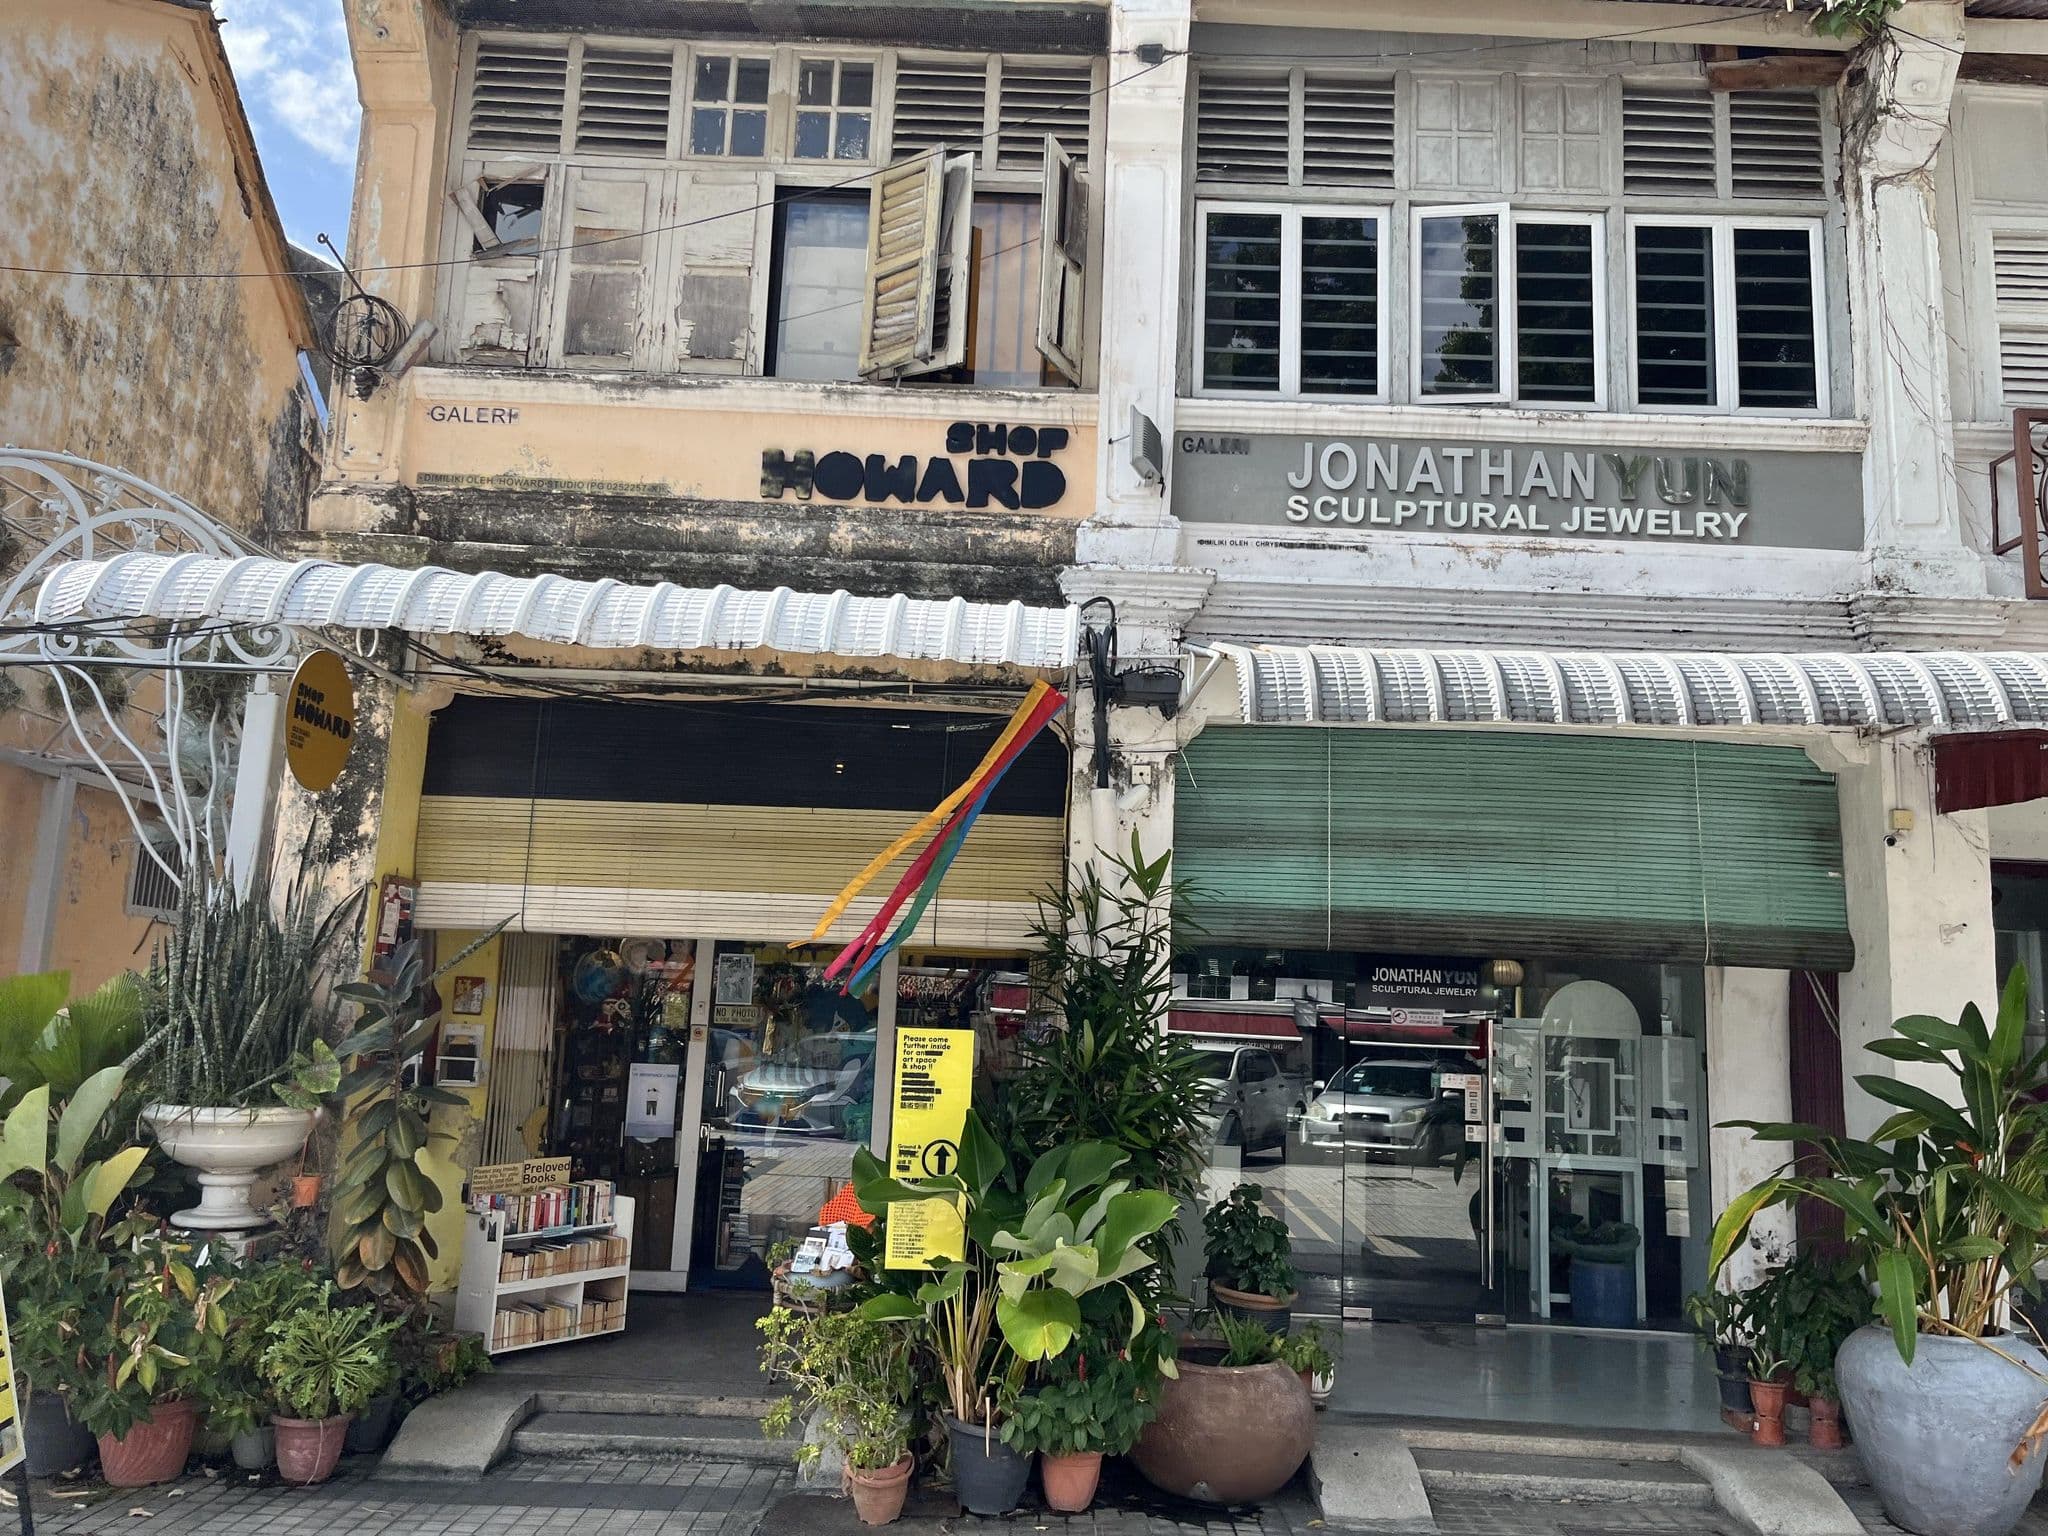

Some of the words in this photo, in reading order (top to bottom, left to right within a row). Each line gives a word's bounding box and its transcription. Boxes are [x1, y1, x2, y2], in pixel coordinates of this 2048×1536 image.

[945, 421, 1069, 458] SHOP
[760, 448, 1067, 511] HOWARD
[1287, 441, 1595, 500] JONATHAN
[1602, 453, 1750, 506] YUN
[1286, 495, 1550, 530] SCULPTURAL
[1560, 506, 1749, 538] JEWELRY
[298, 683, 324, 704] SHOP
[294, 698, 351, 739] HOWARD
[1371, 967, 1441, 984] JONATHAN
[1444, 970, 1478, 985] YUN
[1371, 984, 1433, 995] SCULPTURAL
[1434, 987, 1478, 997] JEWELRY
[903, 1034, 926, 1042] Please
[910, 1063, 927, 1071] shop
[523, 1161, 571, 1174] Preloved
[522, 1173, 557, 1185] Books
